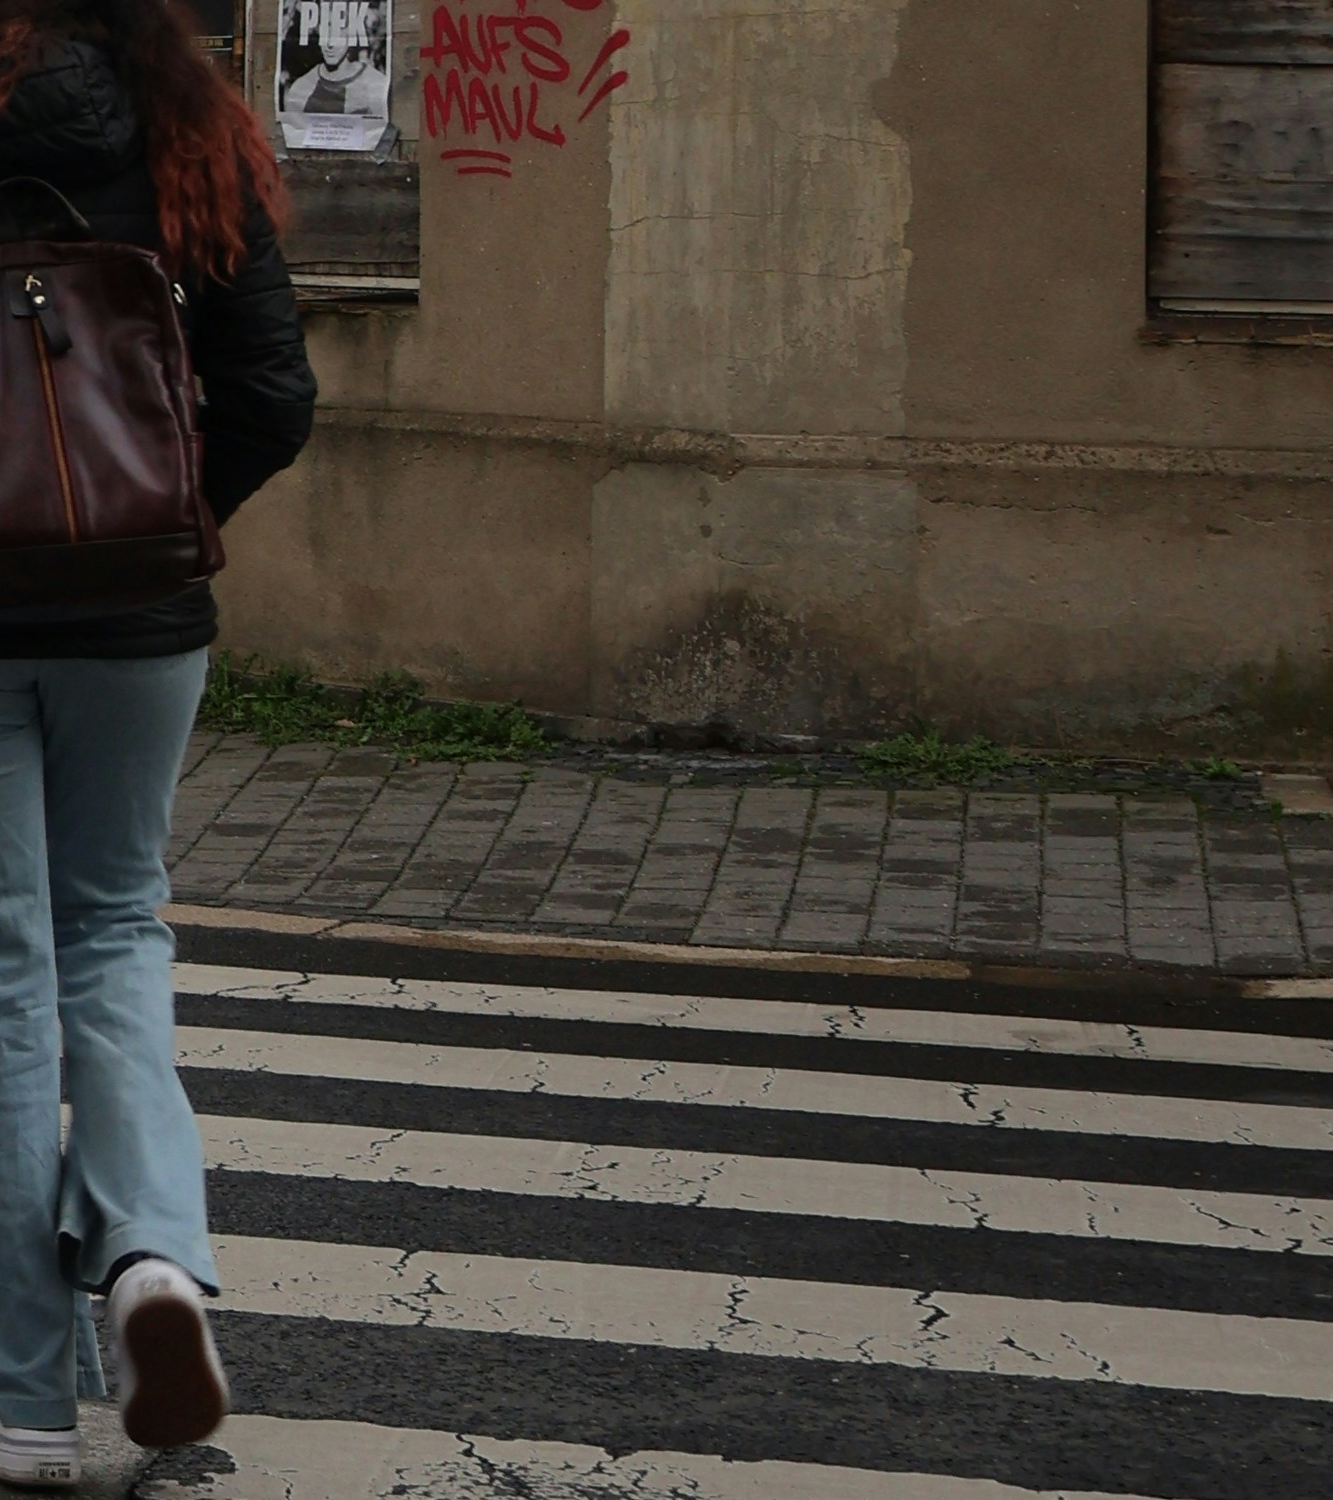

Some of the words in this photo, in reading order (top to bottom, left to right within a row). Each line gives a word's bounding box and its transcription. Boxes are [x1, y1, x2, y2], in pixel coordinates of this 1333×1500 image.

[298, 1, 370, 47] PIEK
[420, 5, 570, 83] AUFS
[423, 68, 566, 147] MAUL
